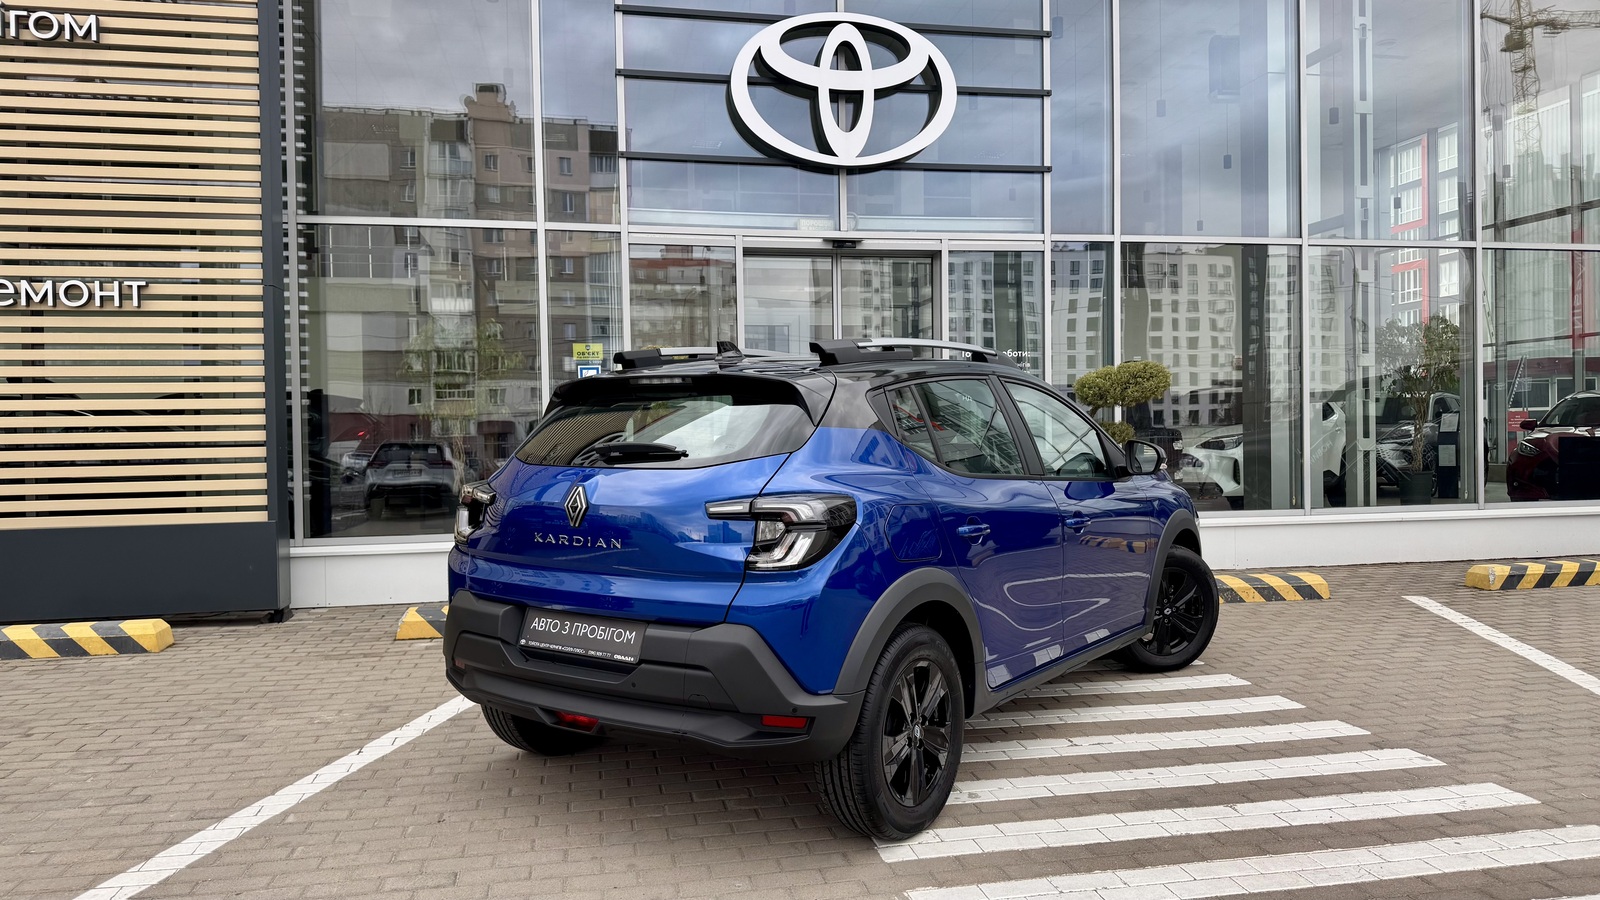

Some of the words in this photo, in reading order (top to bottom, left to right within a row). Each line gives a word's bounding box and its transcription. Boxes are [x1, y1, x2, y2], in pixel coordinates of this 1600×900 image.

[534, 532, 622, 549] KARDIAN
[530, 617, 560, 633] АВТО
[561, 621, 570, 634] З
[571, 622, 636, 644] ПРОБІГОМ
